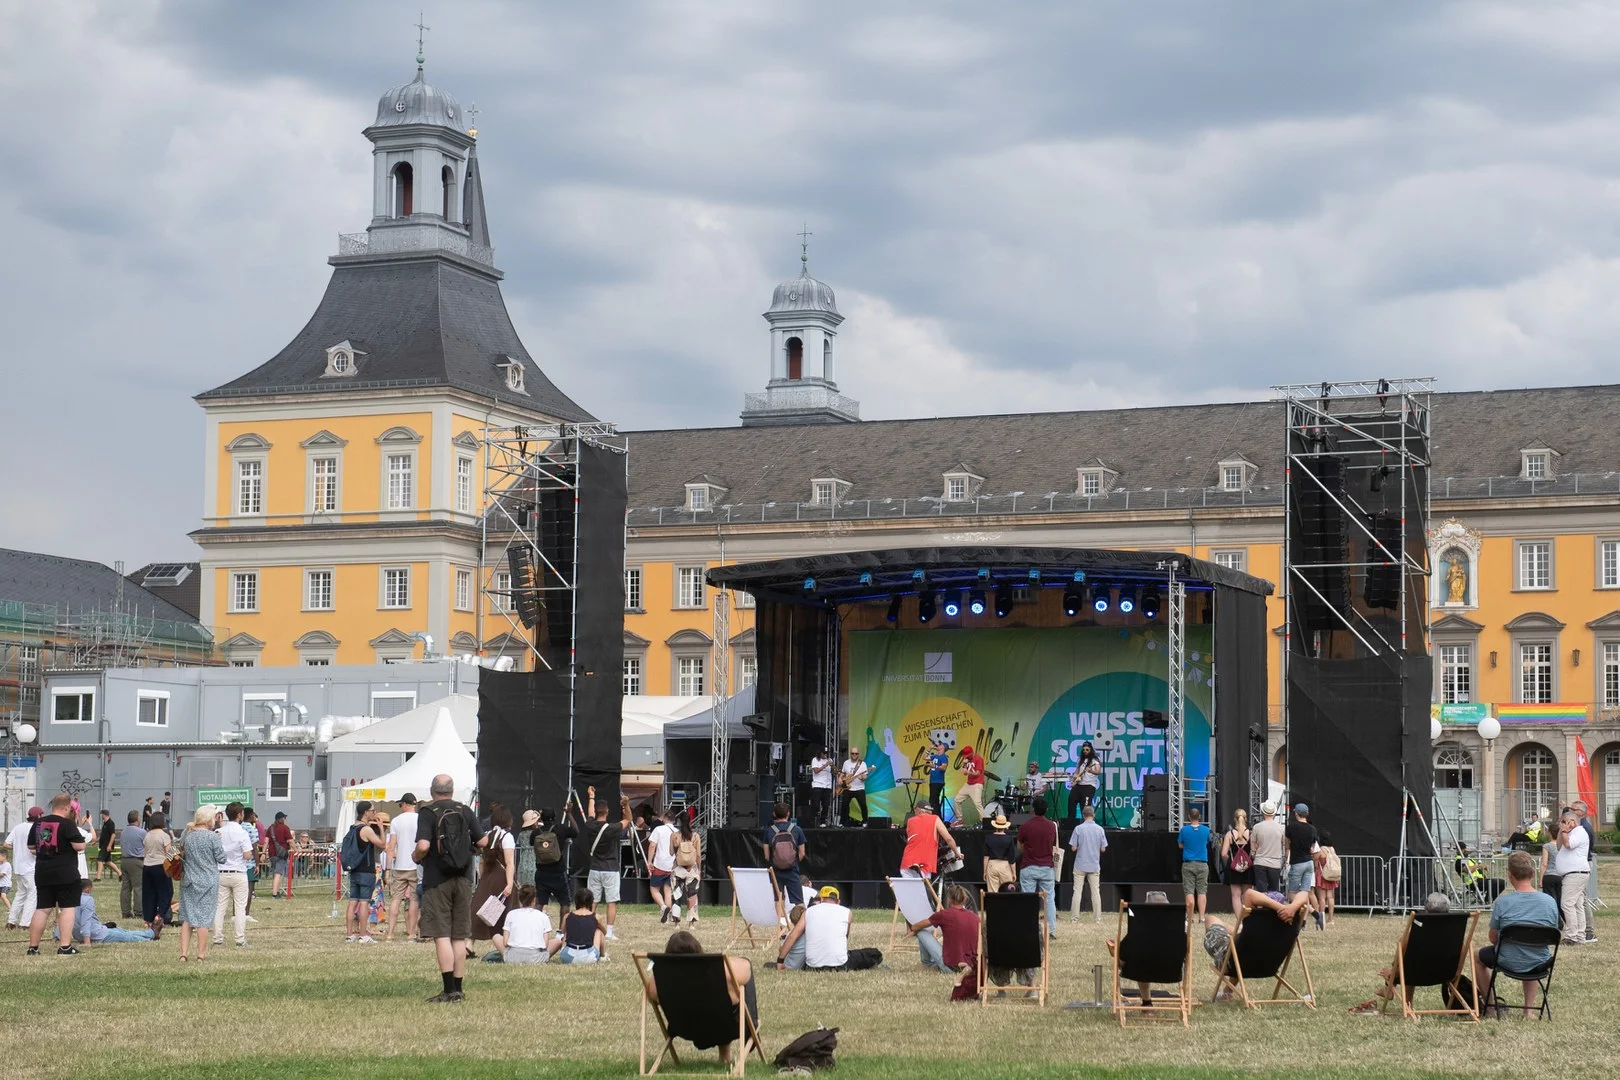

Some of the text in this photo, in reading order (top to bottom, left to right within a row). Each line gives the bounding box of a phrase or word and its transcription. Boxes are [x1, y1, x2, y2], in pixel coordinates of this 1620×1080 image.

[925, 674, 945, 682] BONN
[904, 710, 967, 733] WISSENSCHAFT
[1069, 711, 1181, 736] WISS
[903, 731, 922, 743] ZUM
[201, 793, 246, 801] NOTAUSGANG
[1105, 796, 1144, 808] HOFG
